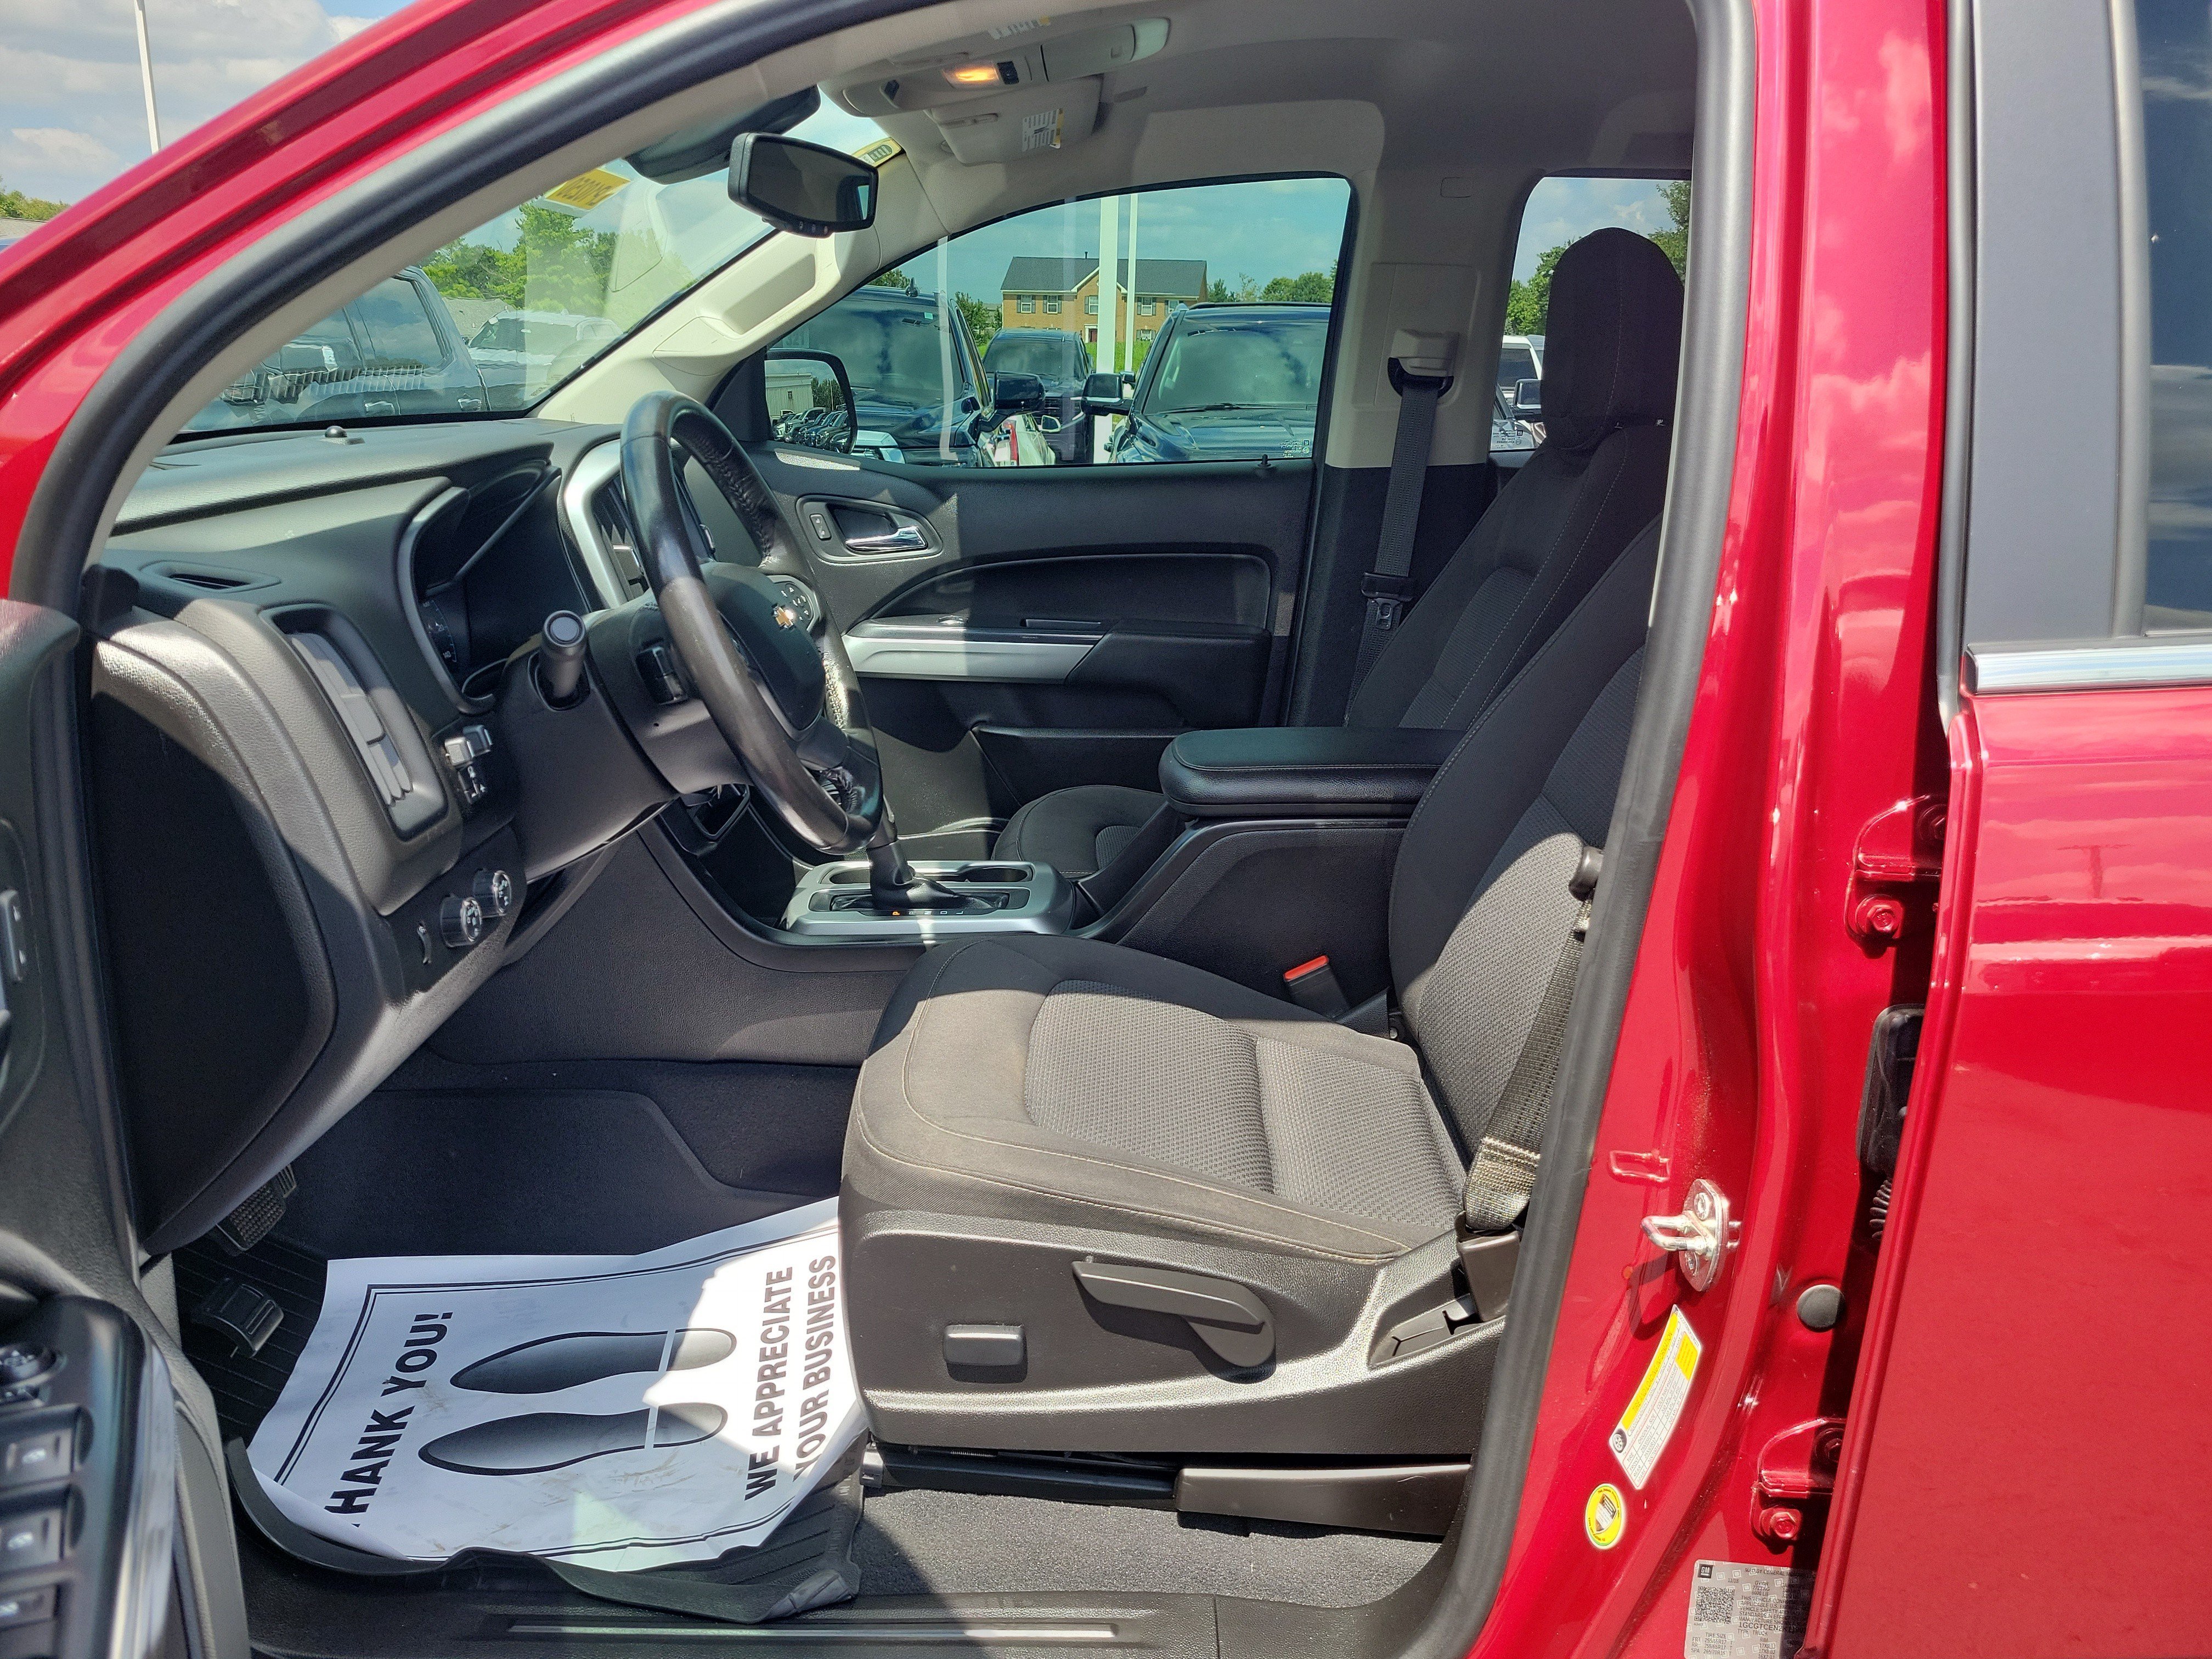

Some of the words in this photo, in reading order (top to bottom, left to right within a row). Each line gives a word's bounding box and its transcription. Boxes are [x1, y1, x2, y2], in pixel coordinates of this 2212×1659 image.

[752, 1267, 793, 1436] APPRECIATE
[803, 1255, 836, 1390] BUSINESS
[324, 1405, 415, 1527] HANK
[381, 1312, 453, 1397] YOU!
[744, 1445, 780, 1501] WE
